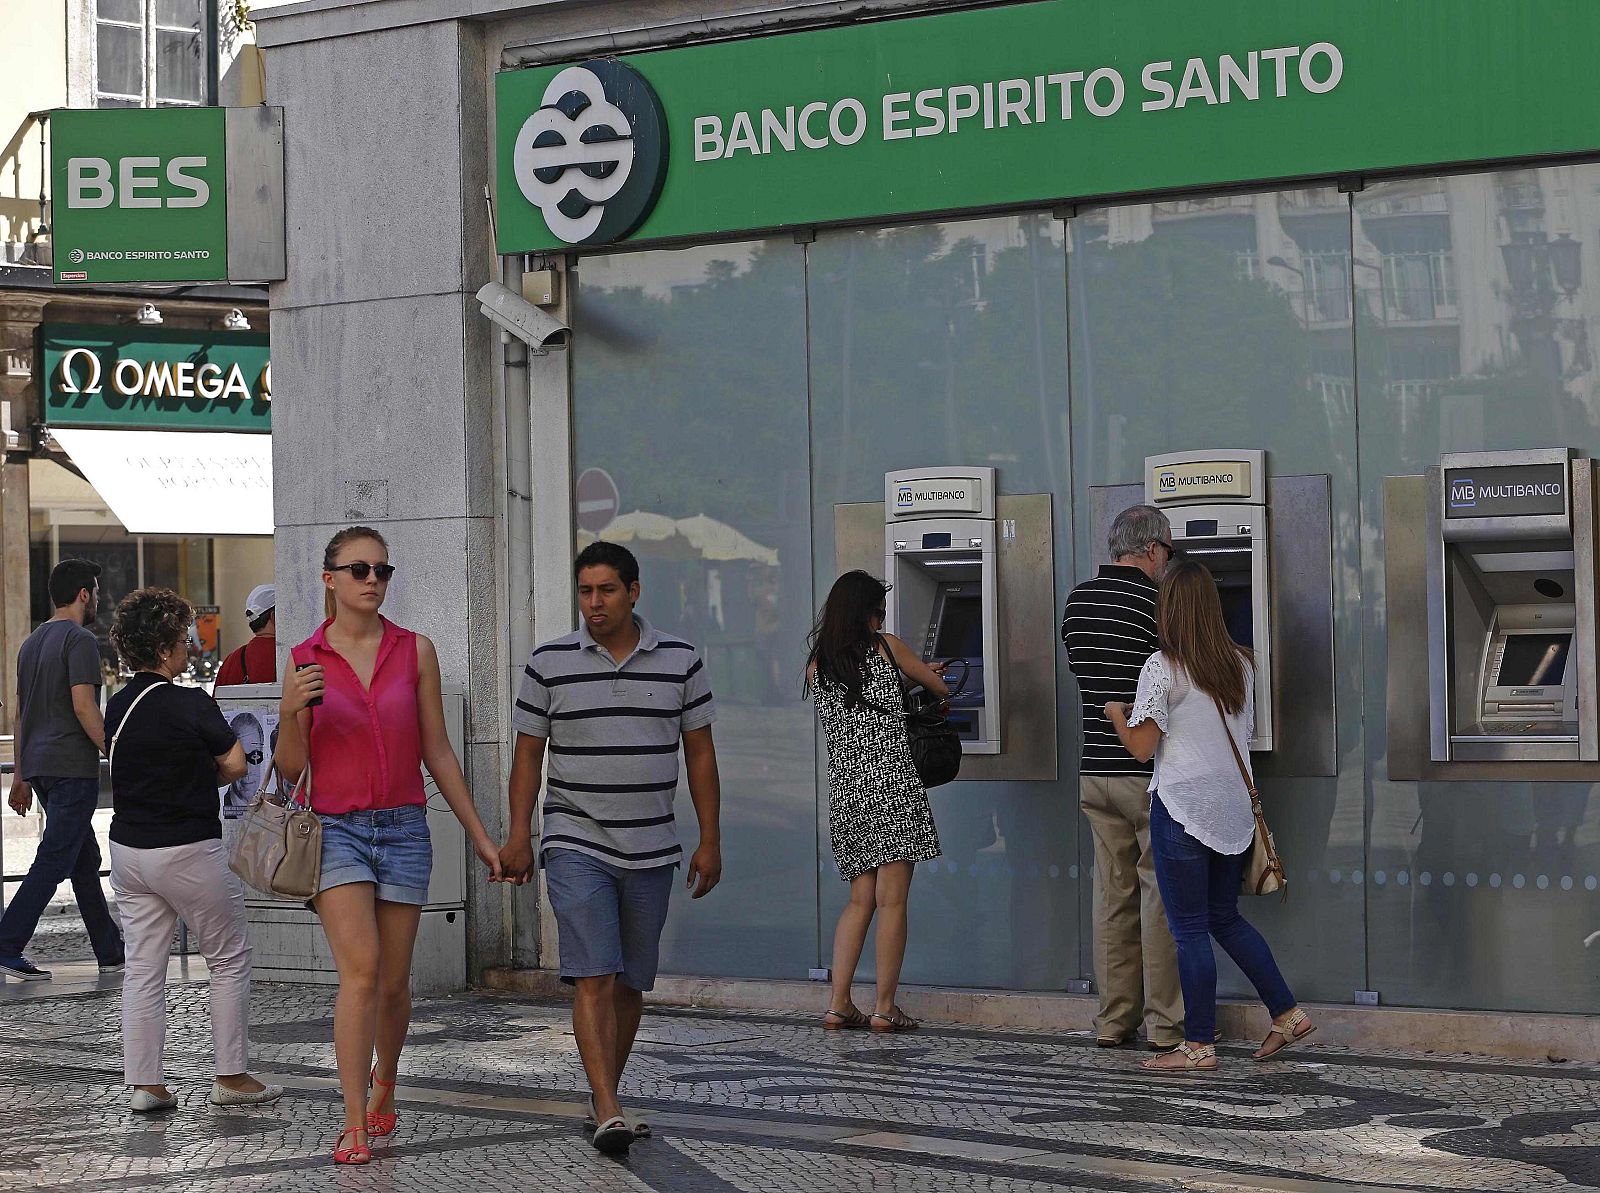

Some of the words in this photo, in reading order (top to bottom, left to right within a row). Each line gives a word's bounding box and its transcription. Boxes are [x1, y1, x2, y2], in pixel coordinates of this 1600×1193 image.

[694, 98, 868, 162] BANCO
[882, 67, 1125, 141] ESPIRITO
[1141, 42, 1344, 112] SANTO
[67, 156, 210, 208] BES
[86, 250, 123, 260] BANCO
[125, 250, 172, 260] ESPIRITO
[173, 250, 210, 259] SANTO
[112, 358, 251, 400] OMEGA
[1160, 477, 1176, 488] MB
[1178, 473, 1234, 486] MULTIBANCO
[897, 492, 913, 502] MB
[914, 490, 965, 501] MULTIBANCO
[1451, 485, 1476, 501] MB
[1479, 483, 1561, 499] MULTIBANCO
